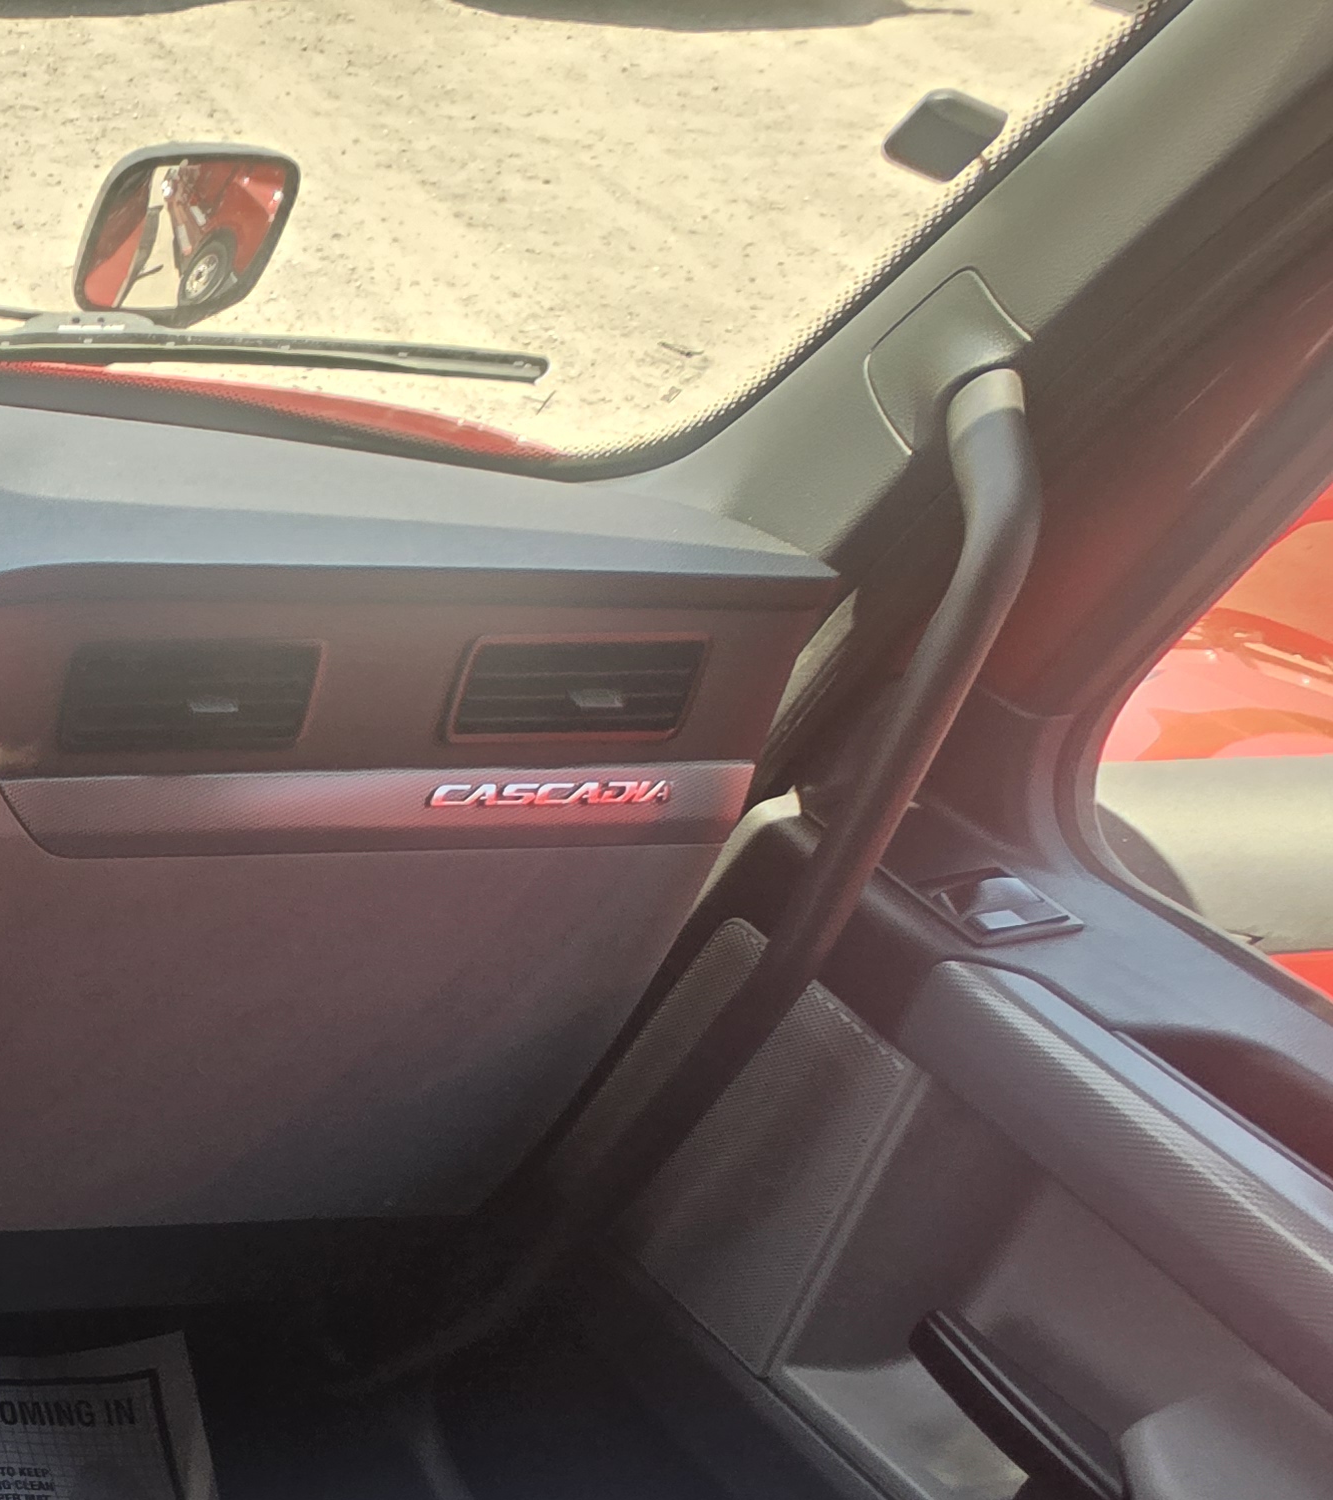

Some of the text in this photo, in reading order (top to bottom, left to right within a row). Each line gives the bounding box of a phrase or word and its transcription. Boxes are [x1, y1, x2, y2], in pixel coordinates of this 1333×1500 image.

[427, 779, 671, 808] CASCADIA
[104, 1398, 136, 1427] IN
[18, 1467, 50, 1478] KEEP
[14, 1481, 55, 1491] CLEAN
